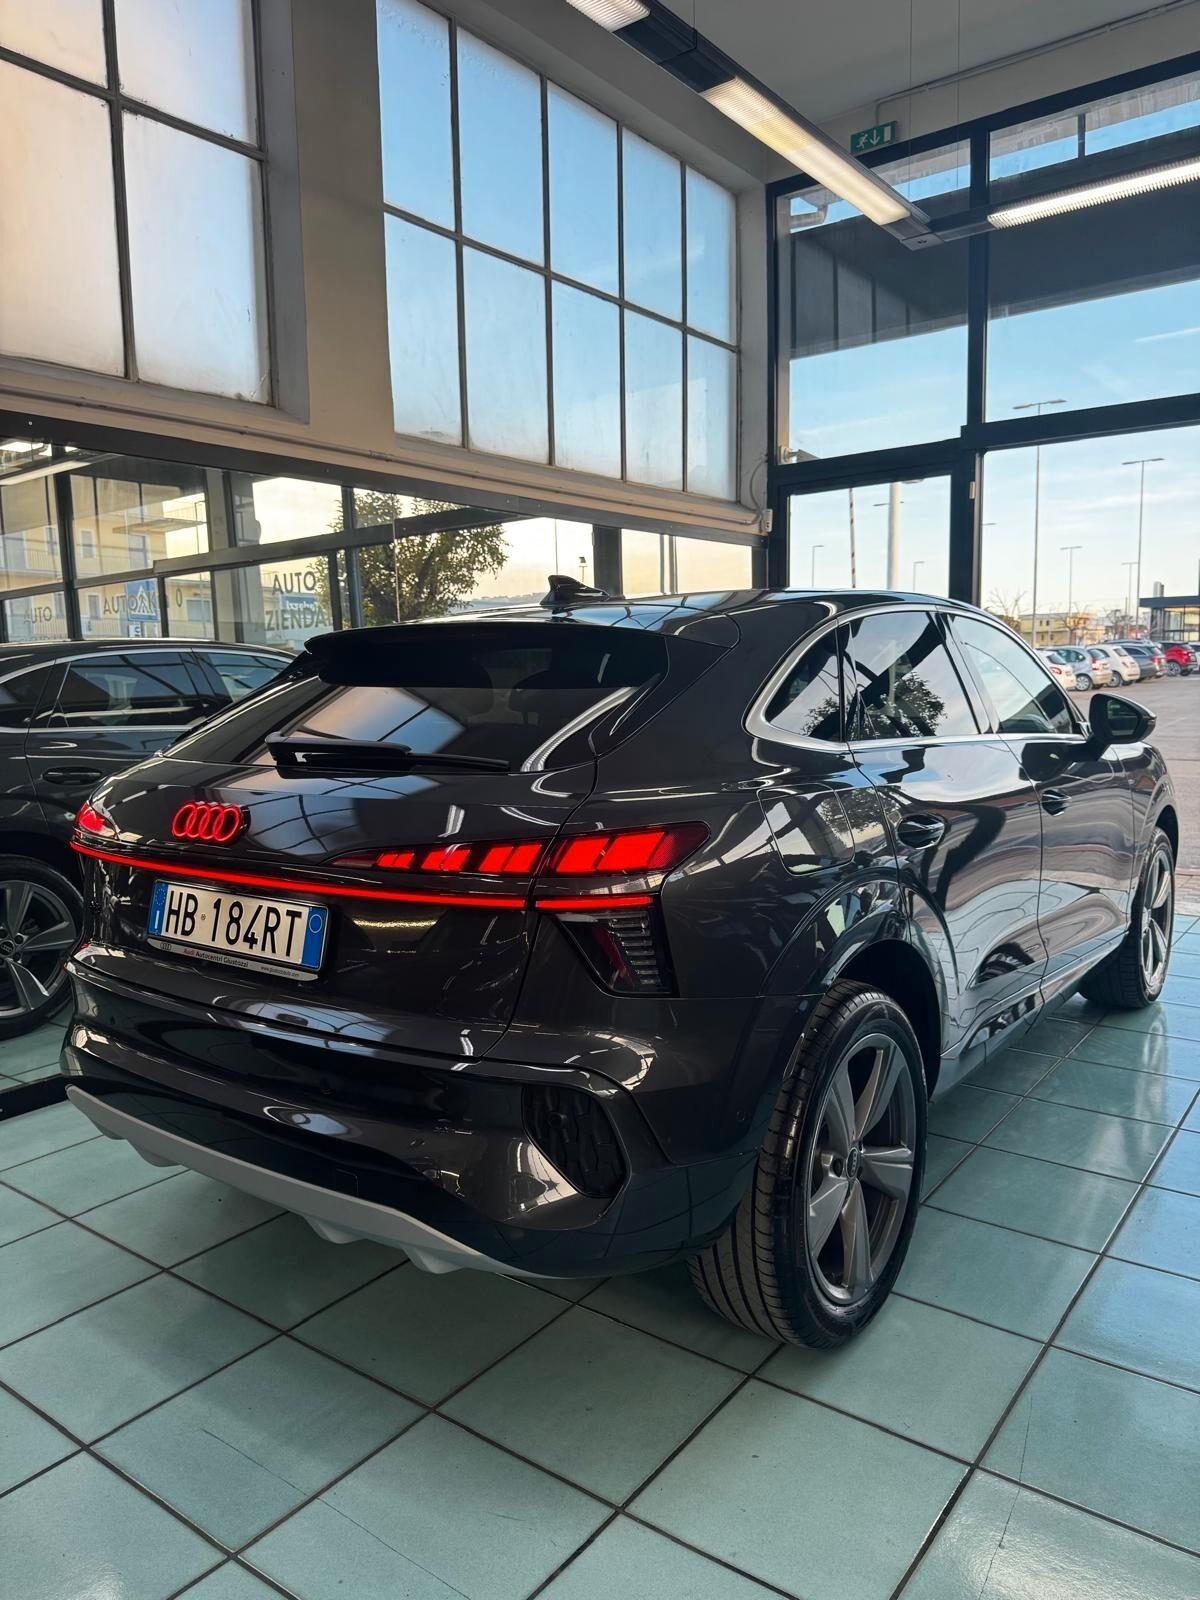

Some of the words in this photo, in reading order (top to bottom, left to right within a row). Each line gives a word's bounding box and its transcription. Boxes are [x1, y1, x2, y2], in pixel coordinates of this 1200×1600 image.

[272, 571, 316, 595] AUTO
[103, 593, 138, 614] AUTO
[24, 606, 52, 624] AUTO
[165, 890, 199, 936] HB
[211, 898, 302, 957] 184RT
[195, 951, 222, 962] Autocentri
